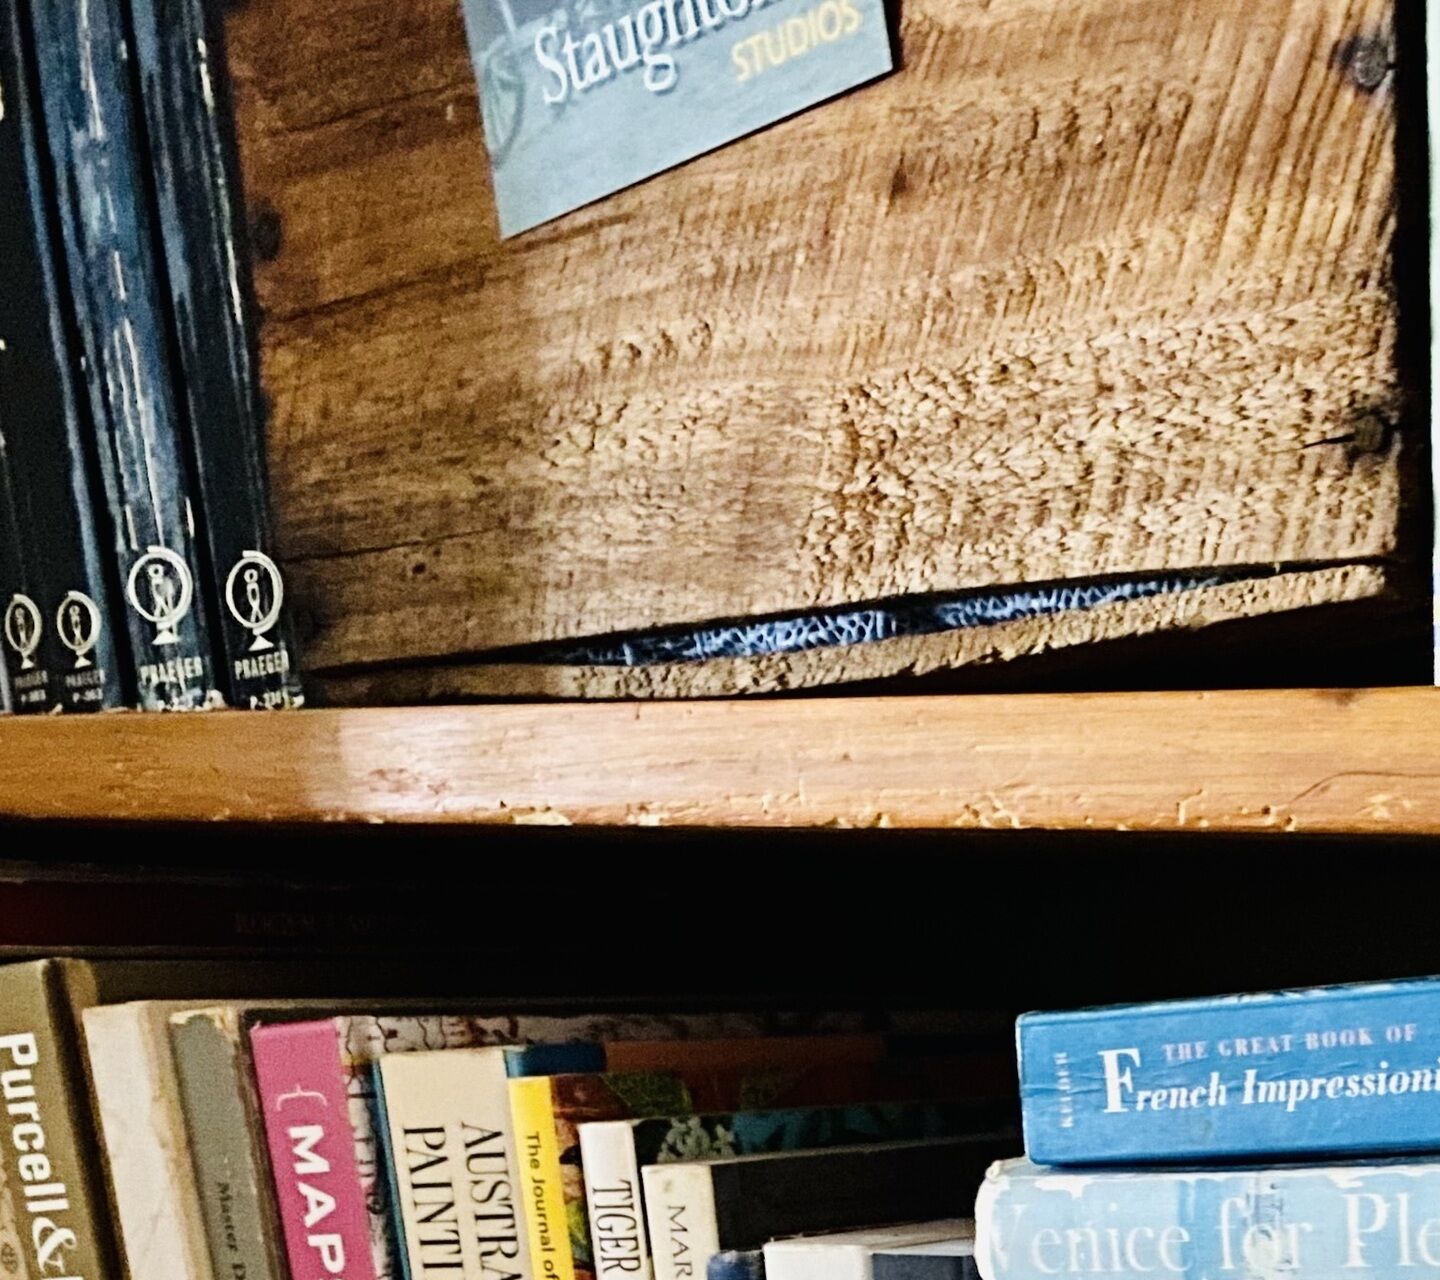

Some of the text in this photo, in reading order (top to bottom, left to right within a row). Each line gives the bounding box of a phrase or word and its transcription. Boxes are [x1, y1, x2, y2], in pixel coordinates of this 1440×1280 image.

[533, 0, 785, 105] Staught
[731, 2, 863, 83] STUDIOS
[235, 650, 289, 681] PRAEGER
[1162, 1023, 1418, 1062] THE GREAT BOOK OF
[1097, 1048, 1227, 1113] French
[0, 1032, 69, 1213] Purcell
[525, 1132, 541, 1165] The
[32, 1217, 78, 1272] &
[217, 1182, 238, 1252] Master
[528, 1171, 556, 1251] Journal
[1213, 1196, 1314, 1273] for
